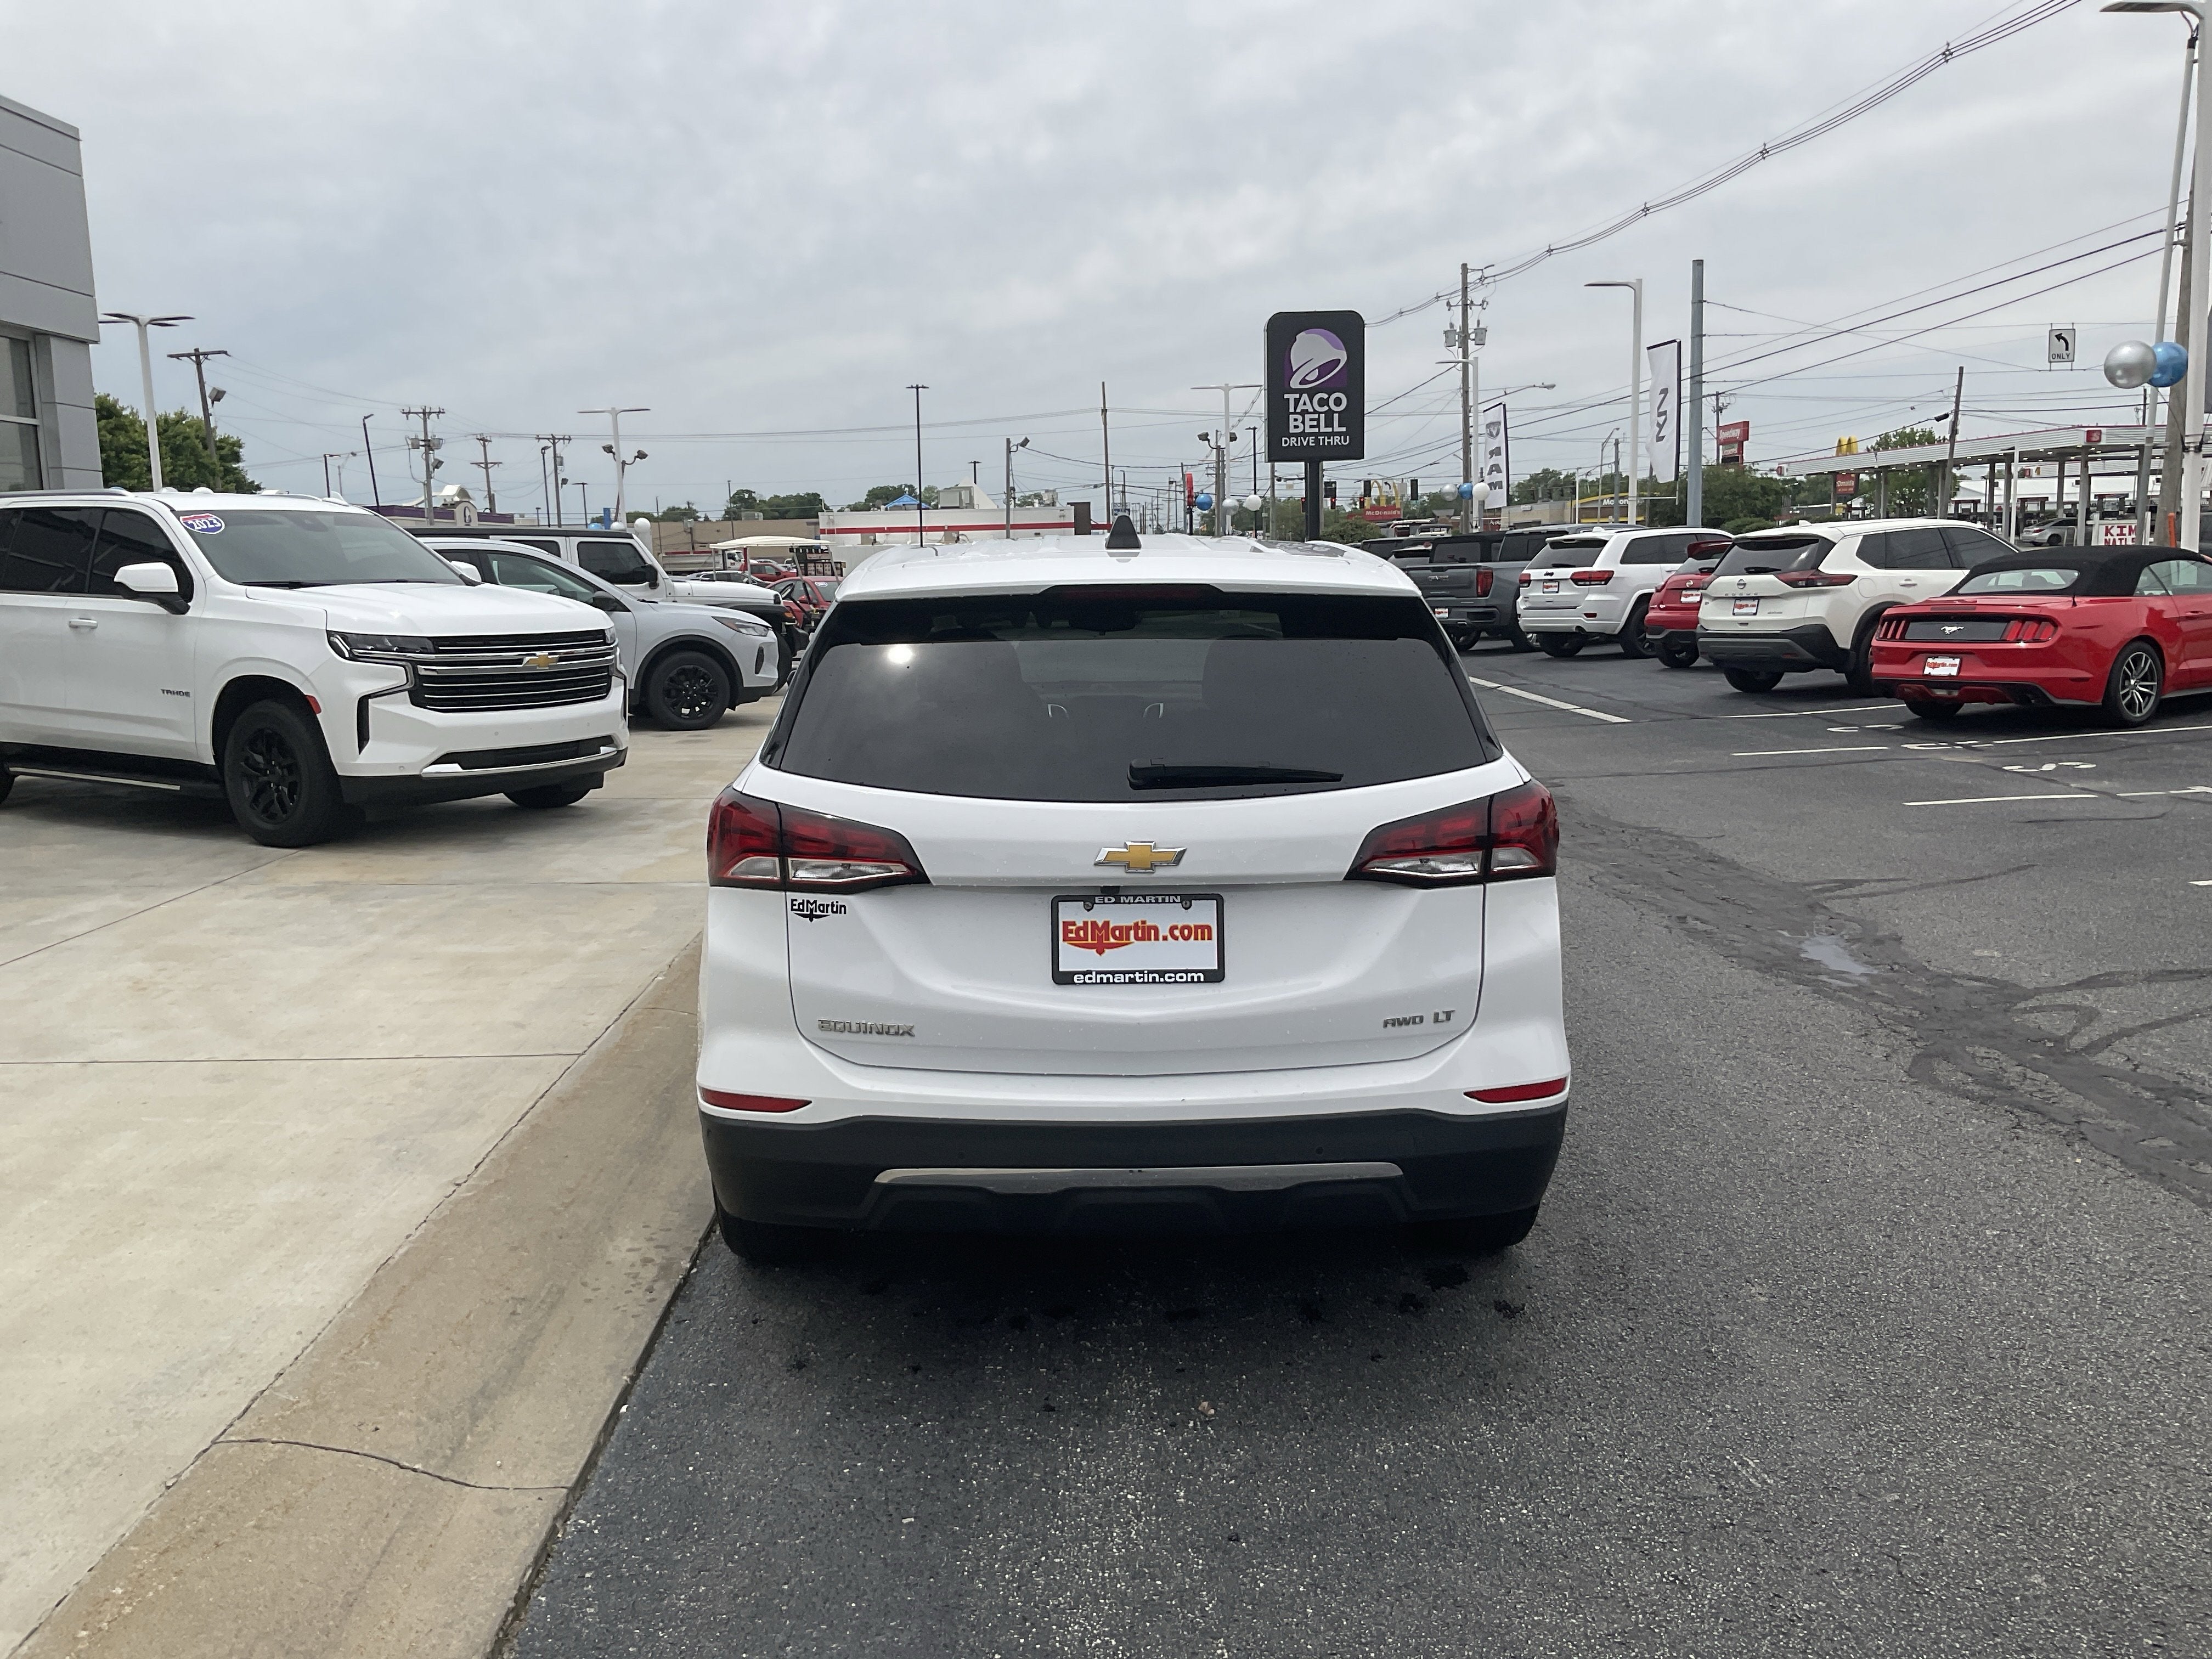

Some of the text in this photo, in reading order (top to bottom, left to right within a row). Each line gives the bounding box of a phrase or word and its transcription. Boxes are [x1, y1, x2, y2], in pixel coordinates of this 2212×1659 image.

[1284, 392, 1347, 413] TACO
[1289, 413, 1347, 433] BELL
[1282, 435, 1350, 447] DRIVE THRU
[187, 518, 222, 530] 2023
[161, 689, 190, 697] TAHOE
[791, 898, 847, 915] EdMartin
[1120, 895, 1181, 904] MARTIN
[1062, 919, 1213, 943] EdMartin.com
[1073, 970, 1204, 984] edmartin.com
[817, 1018, 916, 1037] EQUINOX
[1383, 1009, 1455, 1029] AWD LT
